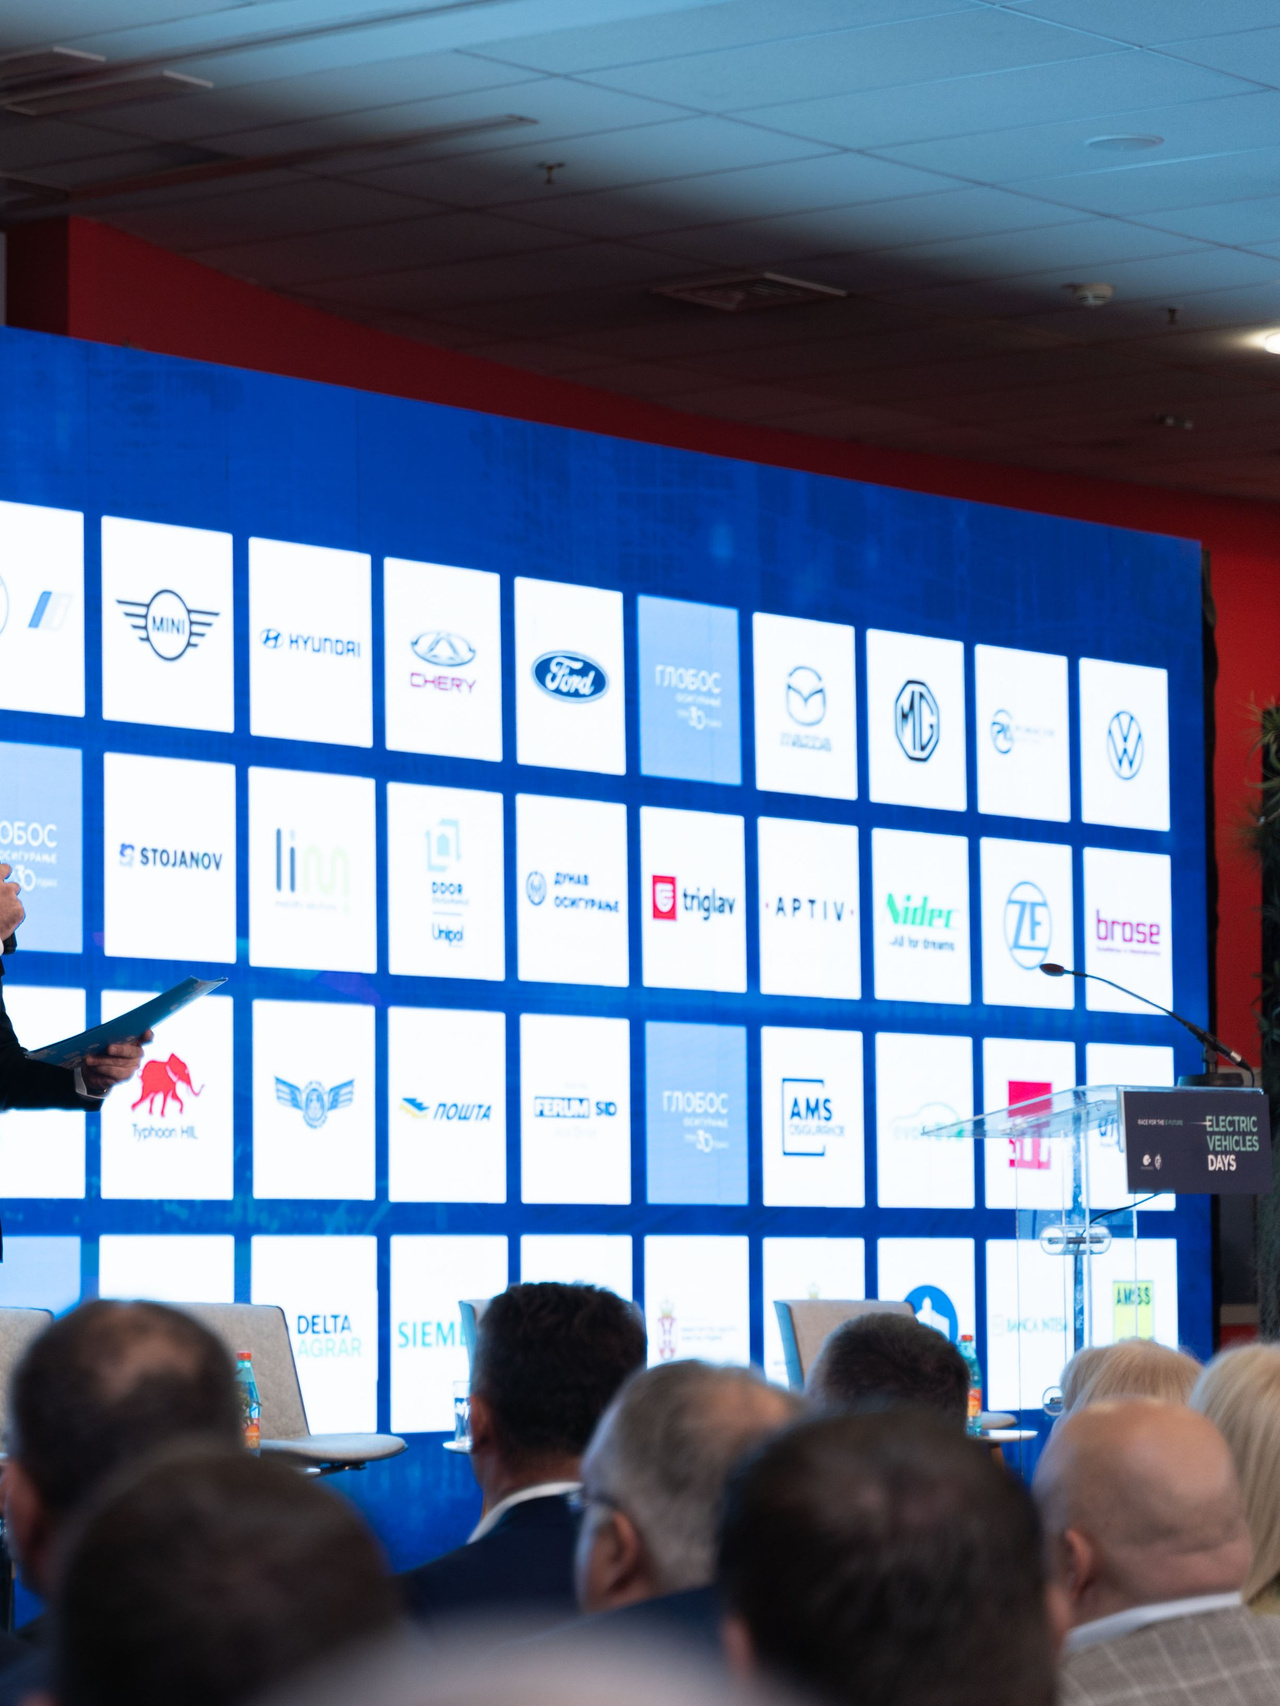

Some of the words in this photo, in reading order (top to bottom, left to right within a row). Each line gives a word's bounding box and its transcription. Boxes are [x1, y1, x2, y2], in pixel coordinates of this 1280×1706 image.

[152, 616, 185, 635] MINI
[289, 633, 361, 658] HYUNDAI
[410, 672, 476, 692] CHERY
[545, 656, 595, 695] Ford
[655, 664, 721, 694] ГЛОБОС
[900, 690, 934, 752] MG
[140, 847, 222, 871] STOJANOV
[683, 887, 736, 921] triglav
[775, 896, 845, 921] APTIV
[1008, 900, 1047, 952] ZF
[1096, 908, 1160, 944] brose
[434, 1103, 492, 1121] ПОШТА
[663, 1091, 729, 1114] ГЛОБОС
[790, 1097, 832, 1121] AMS
[132, 1123, 177, 1142] Typhoon
[181, 1126, 199, 1140] HIL
[1206, 1116, 1258, 1132] ELECTRIC
[1207, 1136, 1260, 1151] VEHICLES
[1208, 1154, 1237, 1171] DAYS
[297, 1314, 352, 1334] DELTA
[398, 1321, 467, 1348] SIEM
[297, 1338, 362, 1358] AGRAR
